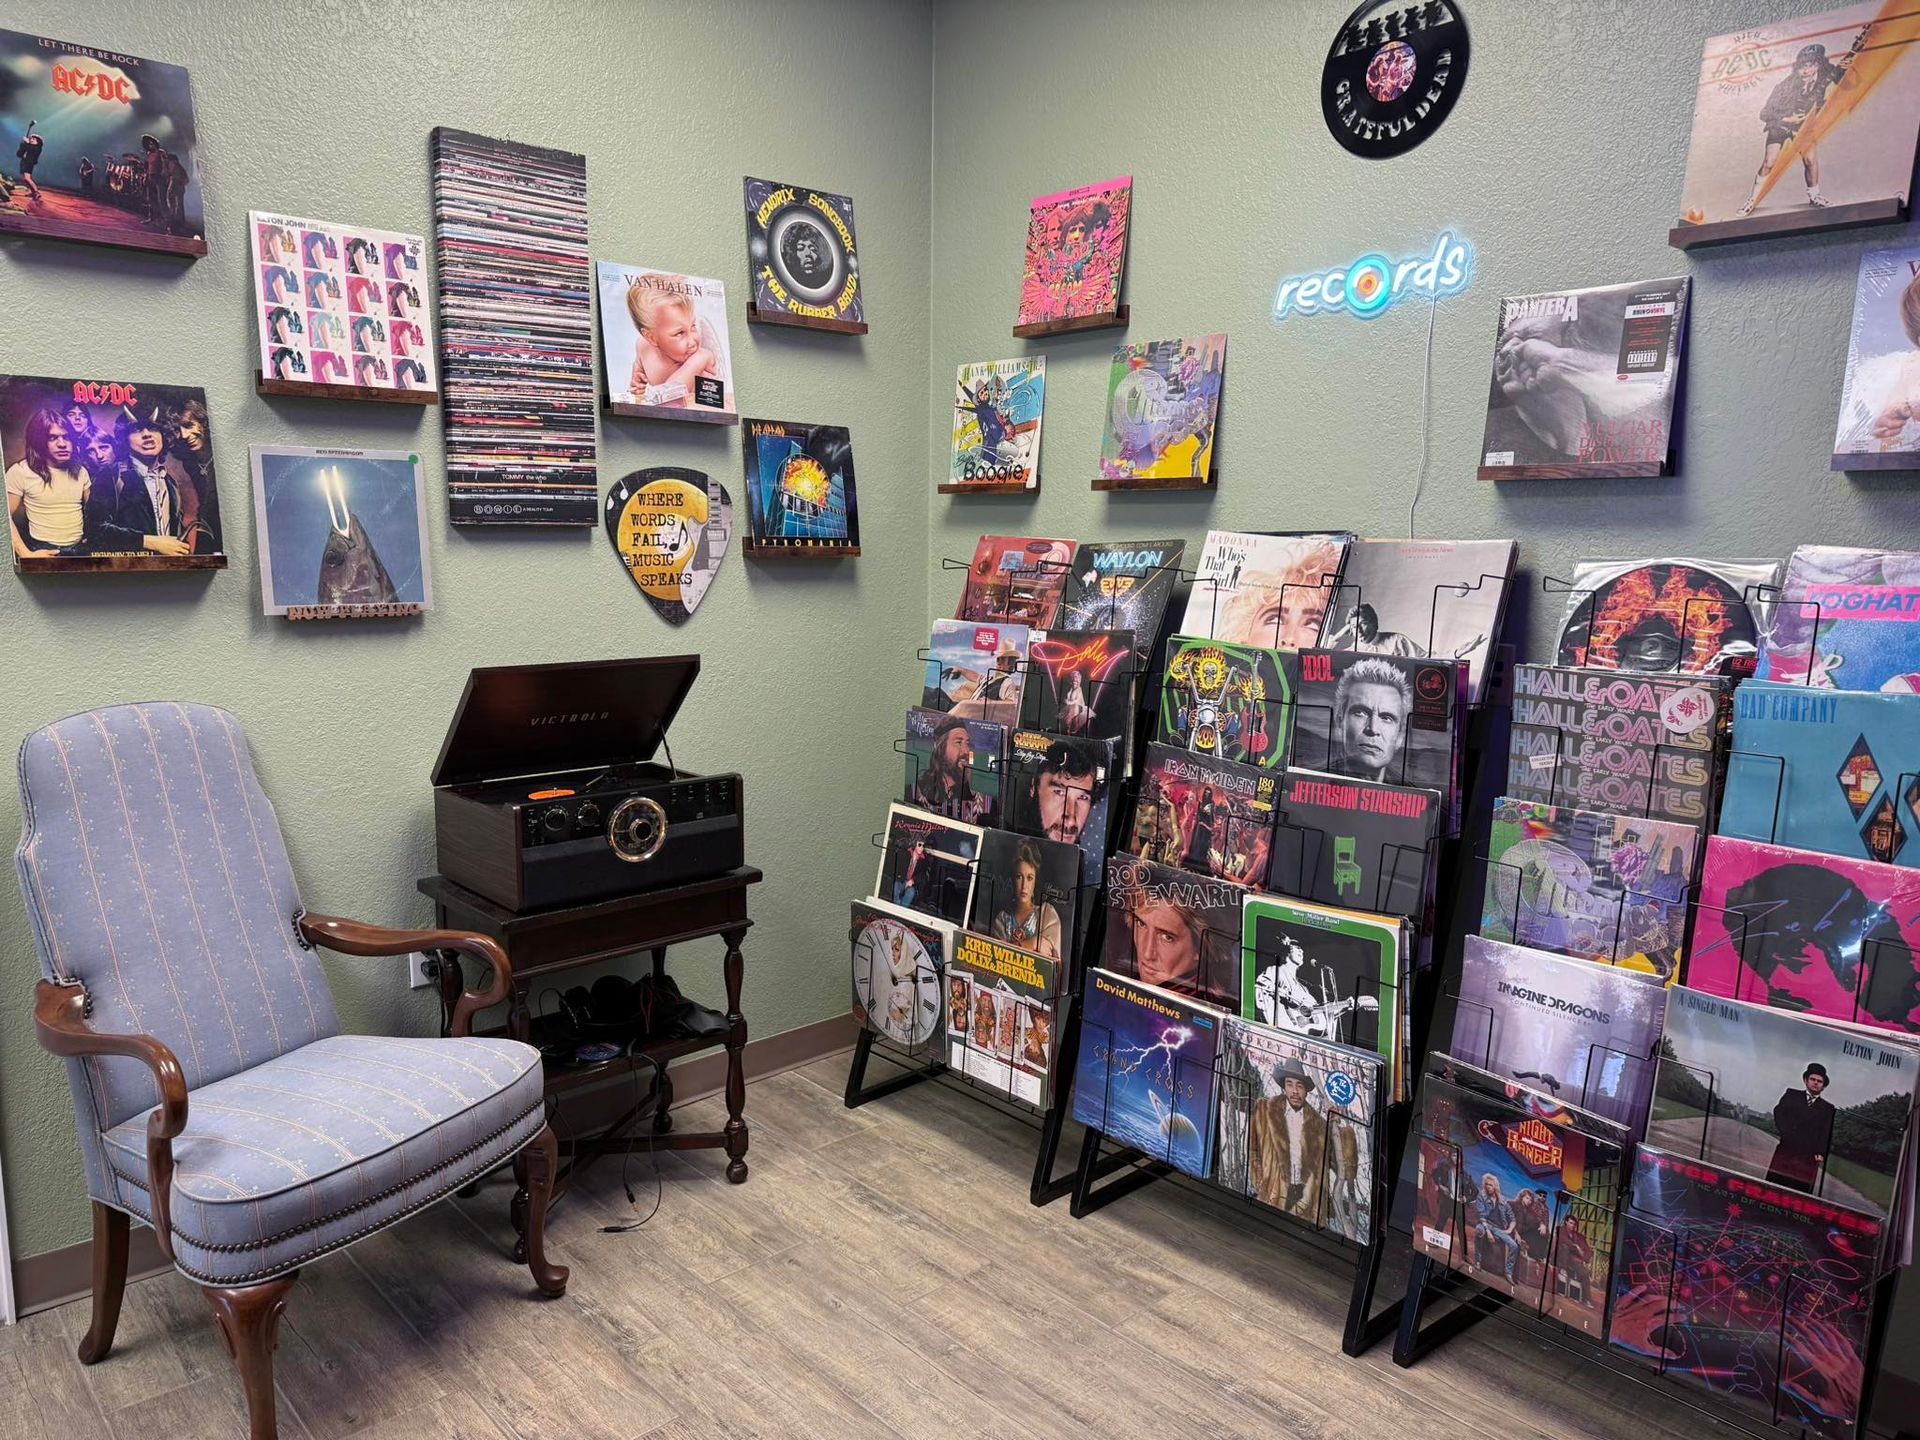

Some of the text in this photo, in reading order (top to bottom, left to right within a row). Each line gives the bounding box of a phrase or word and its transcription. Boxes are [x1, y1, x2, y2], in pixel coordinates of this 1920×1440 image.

[38, 38, 140, 66] LET THERE BE ROCK
[51, 63, 130, 105] AC/DC
[1336, 50, 1452, 141] GRATEFUL DEAD
[285, 219, 307, 229] JOHN
[757, 188, 856, 254] HENDRIX SONGBOOK
[624, 274, 653, 288] VAN
[656, 279, 703, 297] HALEN
[1277, 235, 1465, 311] records
[837, 273, 857, 315] BAND
[1503, 296, 1579, 329] PANTERA
[73, 380, 138, 406] AC/DC
[963, 462, 1024, 484] Boogie
[638, 493, 684, 507] WHERE
[631, 514, 675, 527] WORDS
[632, 533, 667, 549] FAIL,
[1219, 546, 1247, 561] Who's
[632, 553, 674, 567] MUSIC
[1093, 550, 1163, 568] WAYLON
[1205, 556, 1226, 571] That
[640, 574, 692, 587] SPEAKS
[1210, 572, 1229, 588] Girl
[1808, 592, 1920, 612] FOGHAT
[1031, 636, 1109, 678] Dolly
[1302, 655, 1335, 682] IDOL
[531, 712, 609, 726] VICTROLA
[1772, 695, 1838, 724] COMPANY
[1164, 759, 1256, 795] IRON MAIDEN
[1257, 776, 1274, 790] 180
[1290, 780, 1359, 811] JEFFERSON
[1360, 788, 1428, 819] STARSHIP
[1107, 864, 1150, 887] ROD
[1109, 882, 1241, 910] STEWART
[992, 943, 1037, 973] WILLIE,
[1096, 977, 1181, 1020] David Matthews
[1497, 981, 1611, 1025] IMAGINE DRAGONS
[1678, 993, 1740, 1023] A SINGLE MAN
[1842, 1039, 1901, 1070] ELTON JOHN
[1145, 1067, 1194, 1099] CROSS
[1520, 1119, 1555, 1144] NIGHT
[1507, 1129, 1563, 1169] RANGER
[1640, 1152, 1882, 1236] PETER FRAMPTON
[1759, 1203, 1814, 1226] CONTROL
